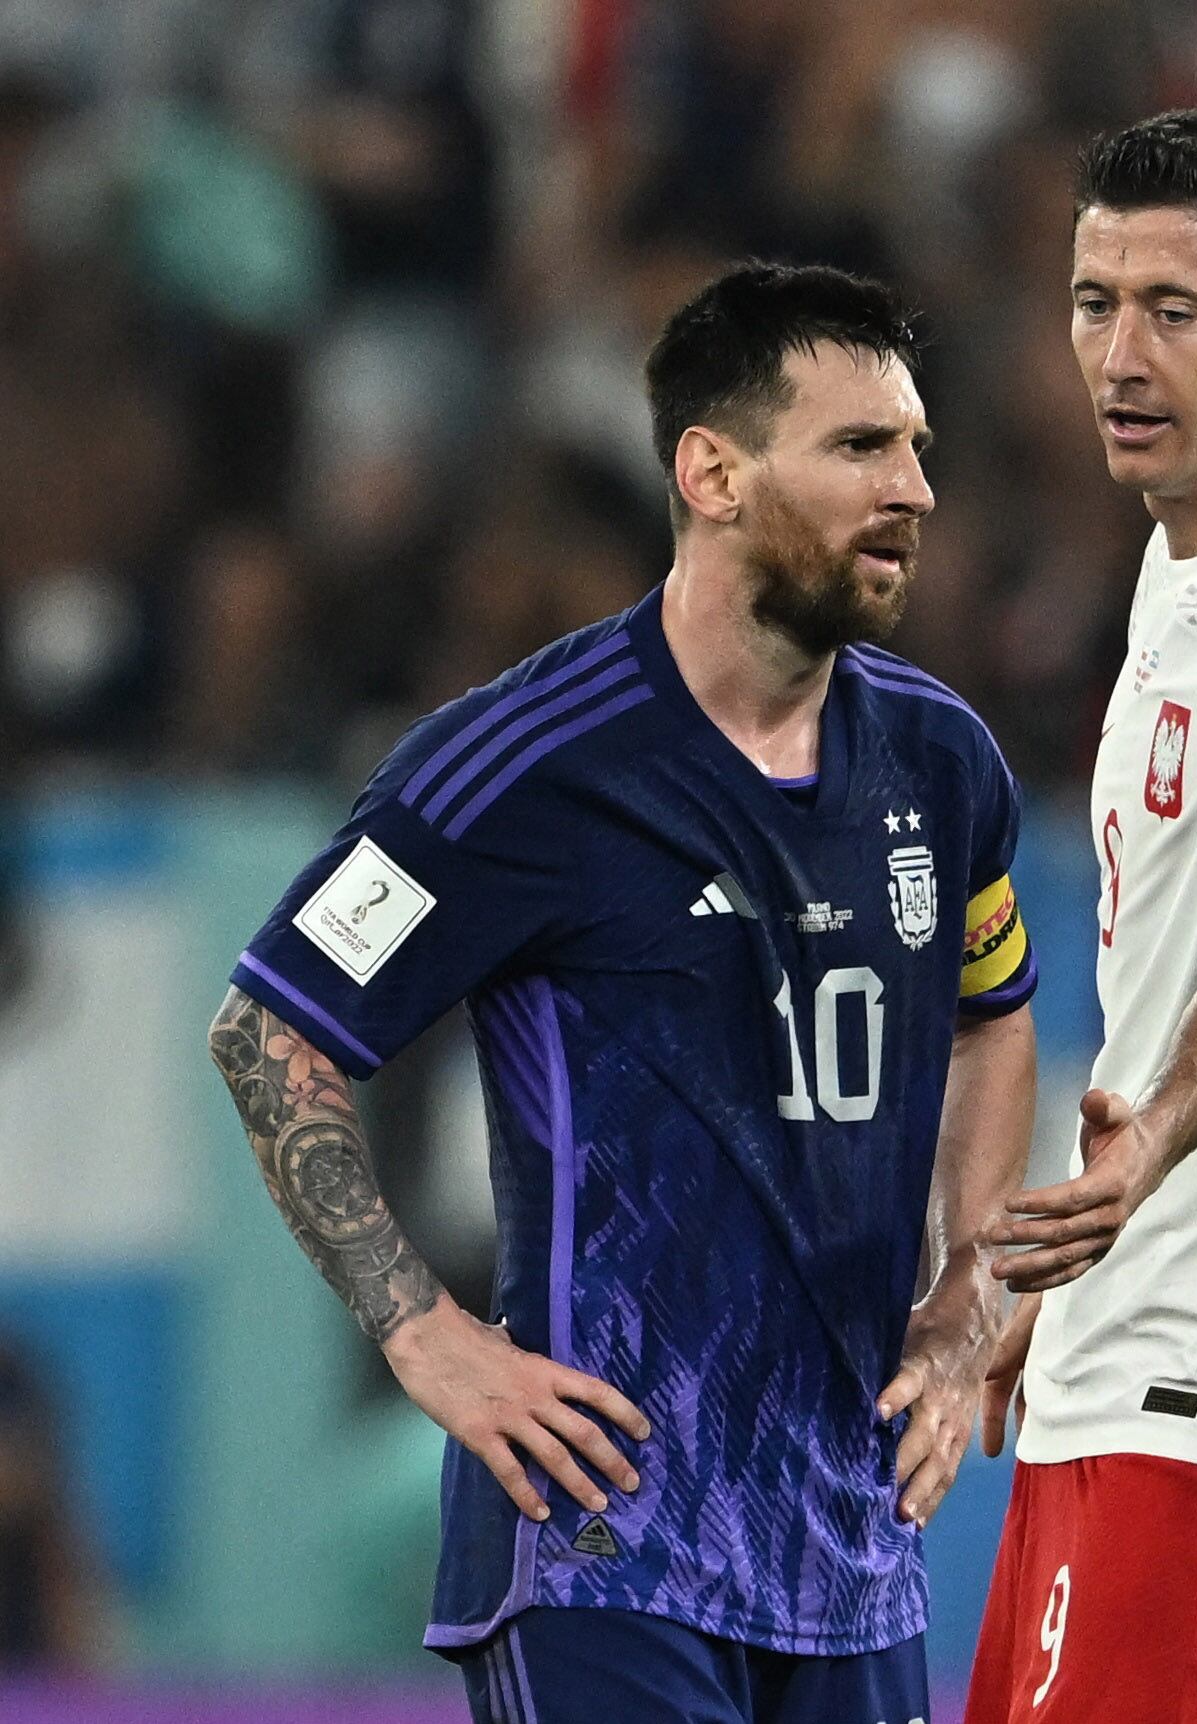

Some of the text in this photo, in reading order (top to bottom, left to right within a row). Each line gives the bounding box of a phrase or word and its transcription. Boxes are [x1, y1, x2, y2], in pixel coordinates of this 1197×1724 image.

[323, 906, 372, 950] FIFA WORLD CUP
[1101, 808, 1123, 948] 9
[774, 966, 885, 1122] 10
[1033, 1564, 1071, 1708] 9
